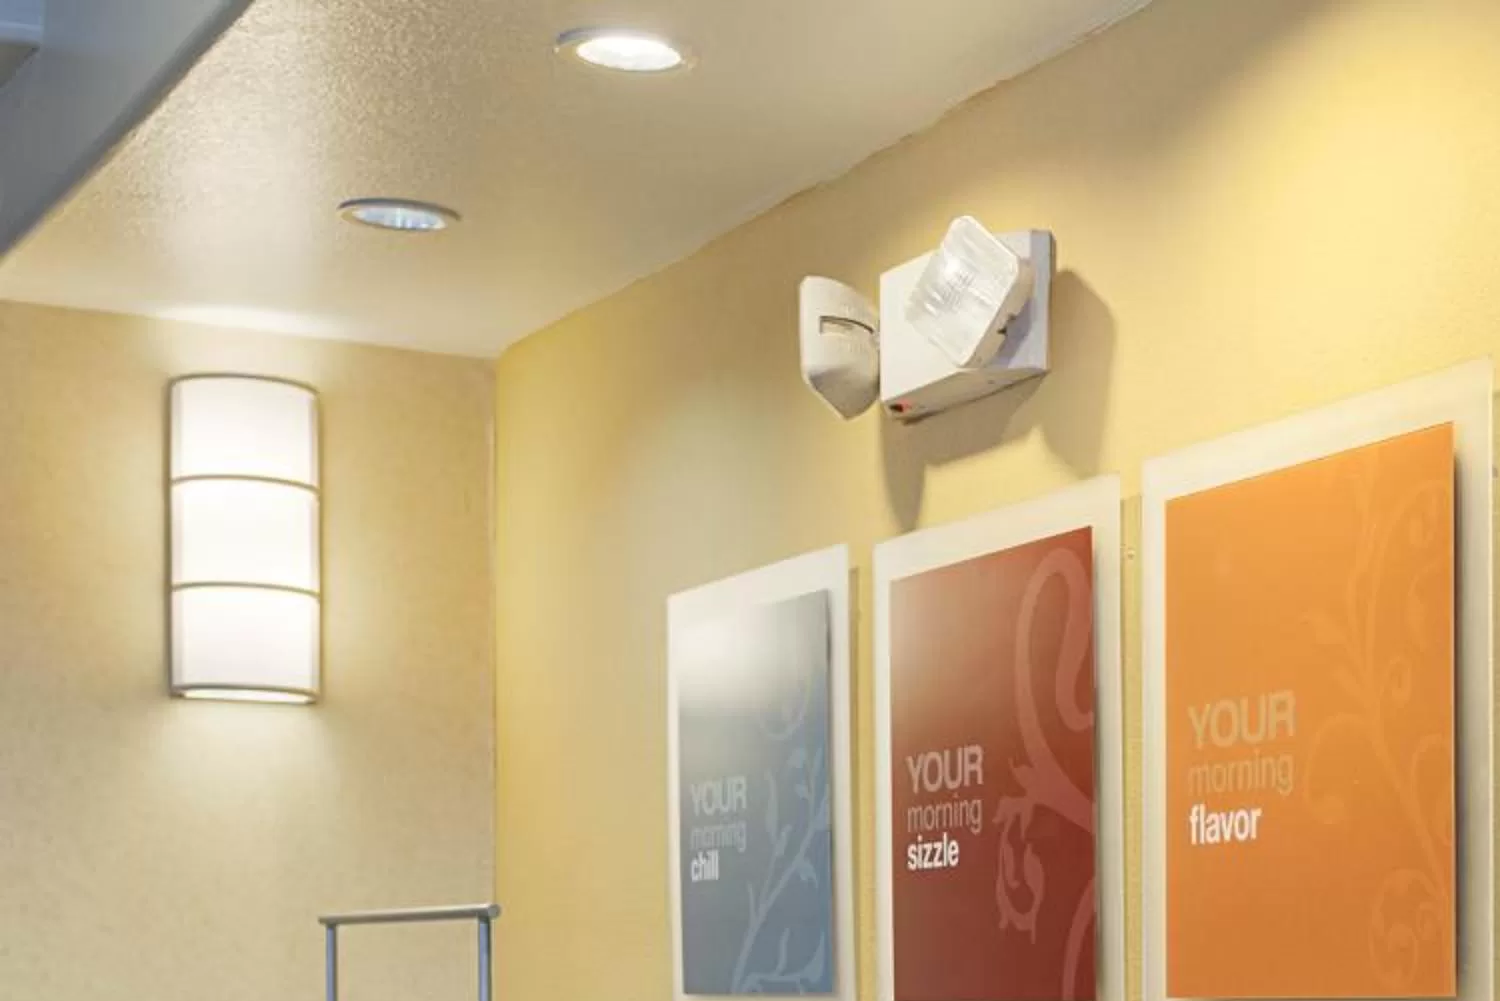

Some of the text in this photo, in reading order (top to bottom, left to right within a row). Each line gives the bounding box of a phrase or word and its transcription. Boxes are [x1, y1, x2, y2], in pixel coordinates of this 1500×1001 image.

[1187, 689, 1297, 750] YOUR
[905, 744, 984, 794] YOUR
[1188, 748, 1294, 797] morning
[690, 776, 747, 816] YOUR
[907, 792, 983, 835] morning
[1189, 801, 1263, 846] flavor
[690, 849, 720, 883] chill
[907, 831, 960, 871] sizzle
